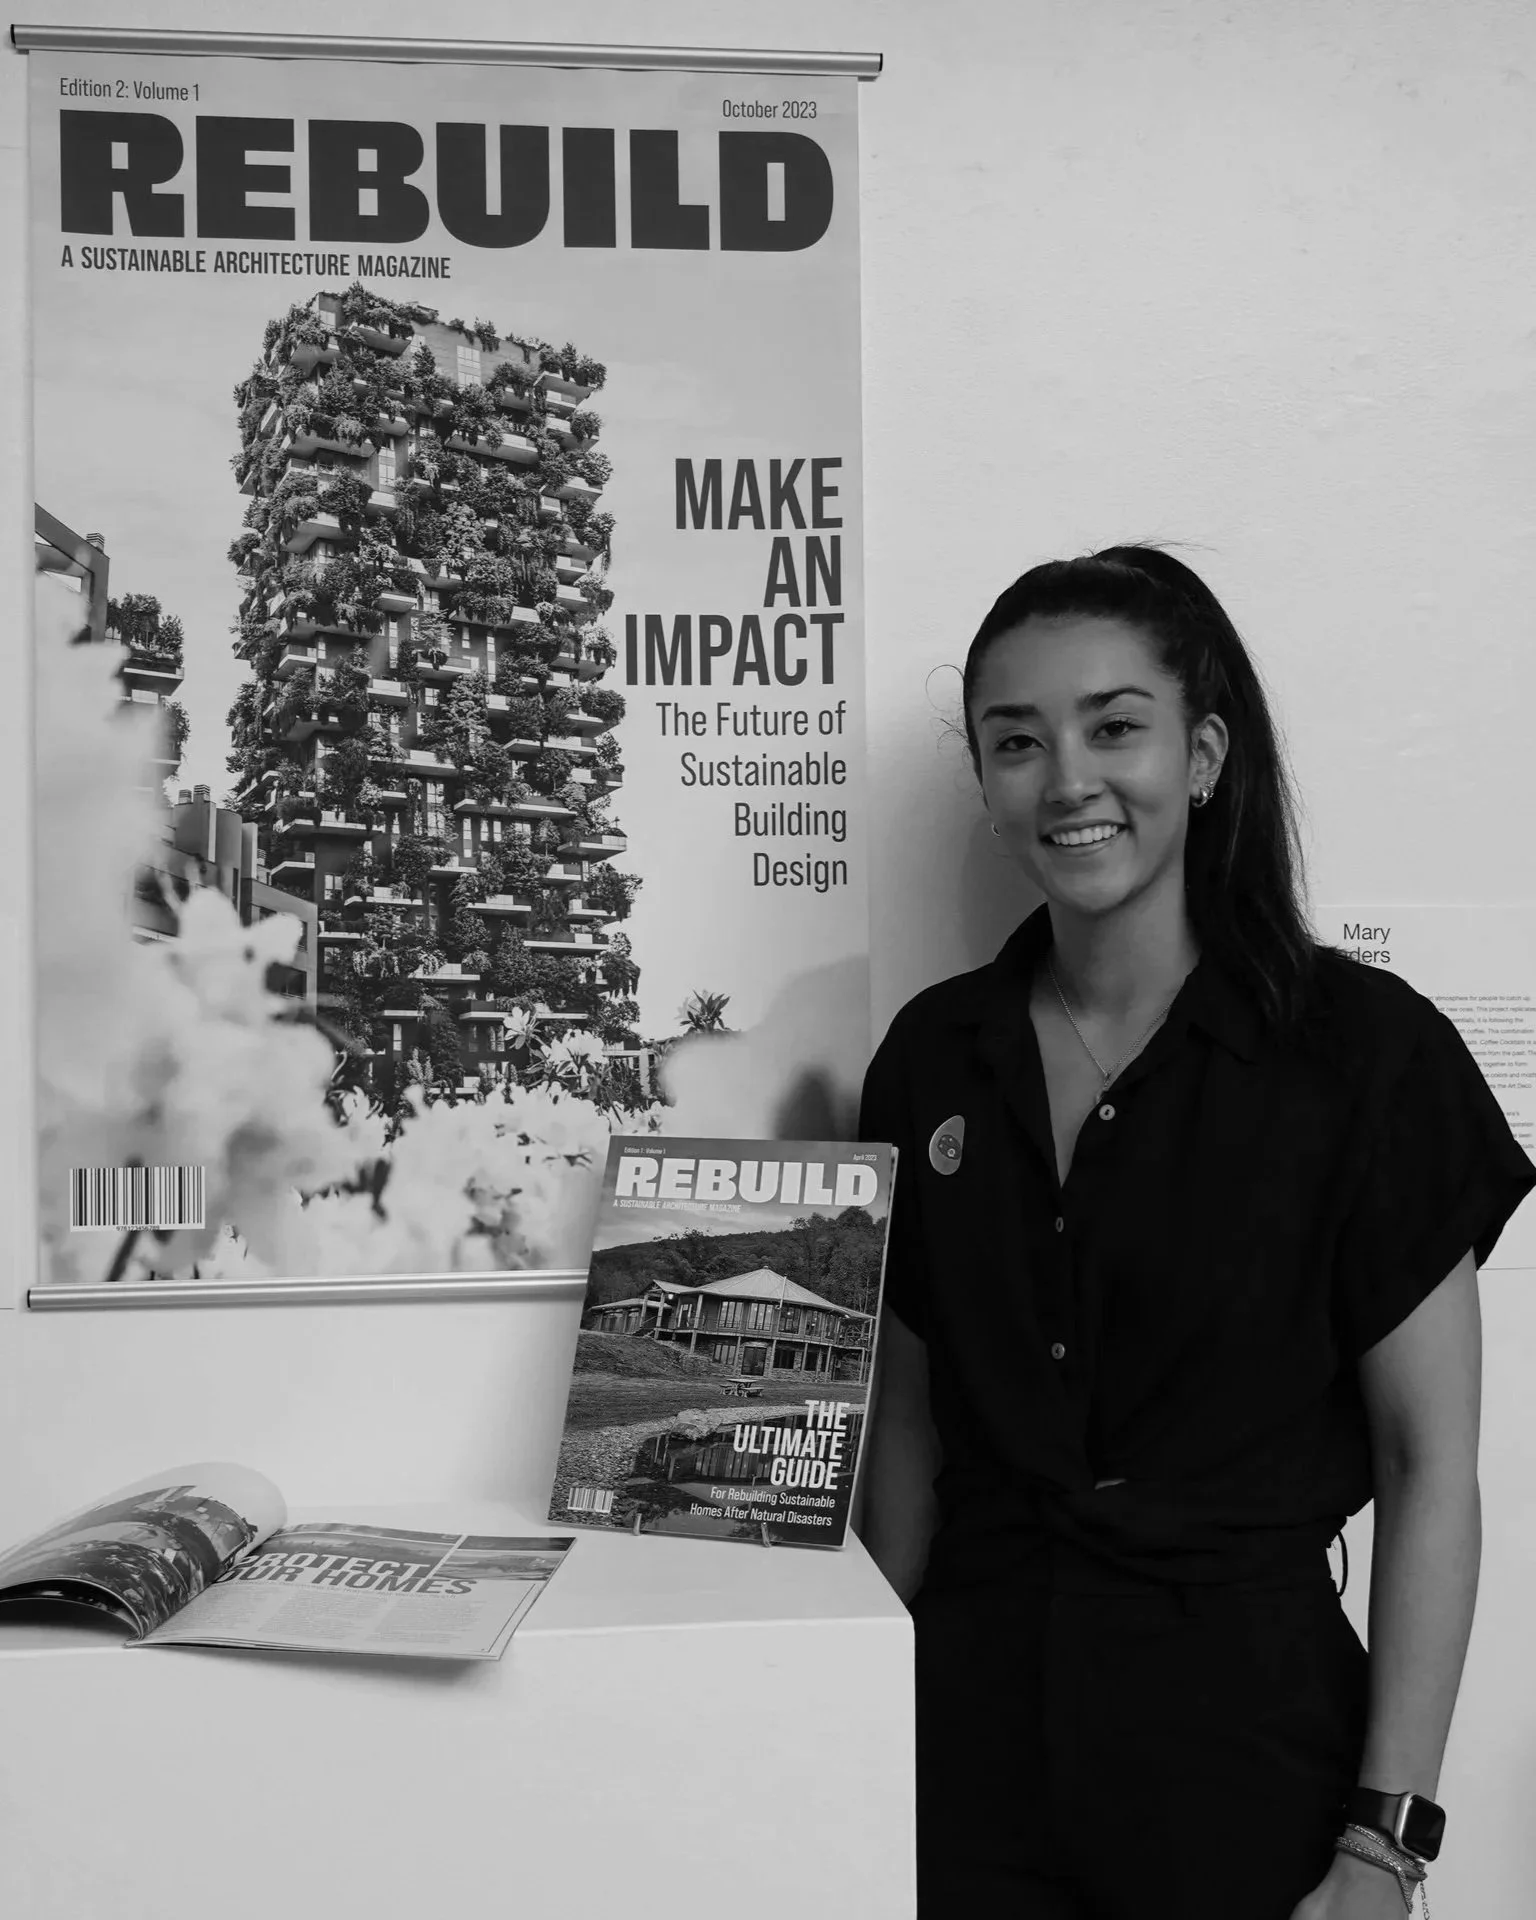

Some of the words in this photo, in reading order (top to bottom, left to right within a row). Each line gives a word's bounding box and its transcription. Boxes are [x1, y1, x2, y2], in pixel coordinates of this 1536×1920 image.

[60, 77, 112, 98] Edition
[116, 79, 129, 99] 2:
[133, 80, 189, 101] Volume
[193, 83, 200, 101] 1
[722, 98, 779, 119] October
[781, 101, 818, 119] 2023
[60, 109, 835, 252] REBUILD
[61, 245, 74, 268] A
[81, 246, 207, 273] SUSTAINABLE
[213, 251, 350, 276] ARCHITECTURE
[357, 255, 451, 279] MAGAZINE
[675, 457, 843, 530] MAKE
[763, 535, 842, 608] AN
[625, 613, 845, 686] IMPACT
[656, 702, 707, 736] The
[716, 702, 809, 736] Future
[818, 700, 847, 735] of
[680, 751, 847, 787] Sustainable
[734, 802, 847, 843] Building
[753, 853, 848, 893] Design
[1343, 923, 1391, 945] Mary
[615, 1156, 878, 1206] REBUILD
[620, 1199, 661, 1209] SUSTAINABLE
[709, 1204, 742, 1213] MAGAZINE
[805, 1400, 850, 1430] THE
[733, 1424, 846, 1460] ULTIMATE
[770, 1458, 838, 1490] GUIDE
[690, 1503, 722, 1517] Homes
[724, 1506, 749, 1519] After
[750, 1508, 787, 1522] Natural
[787, 1511, 832, 1526] Disasters
[710, 1486, 727, 1499] For
[728, 1488, 778, 1506] Rebuilding
[779, 1492, 836, 1508] Sustainable
[311, 1569, 477, 1595] HOMES
